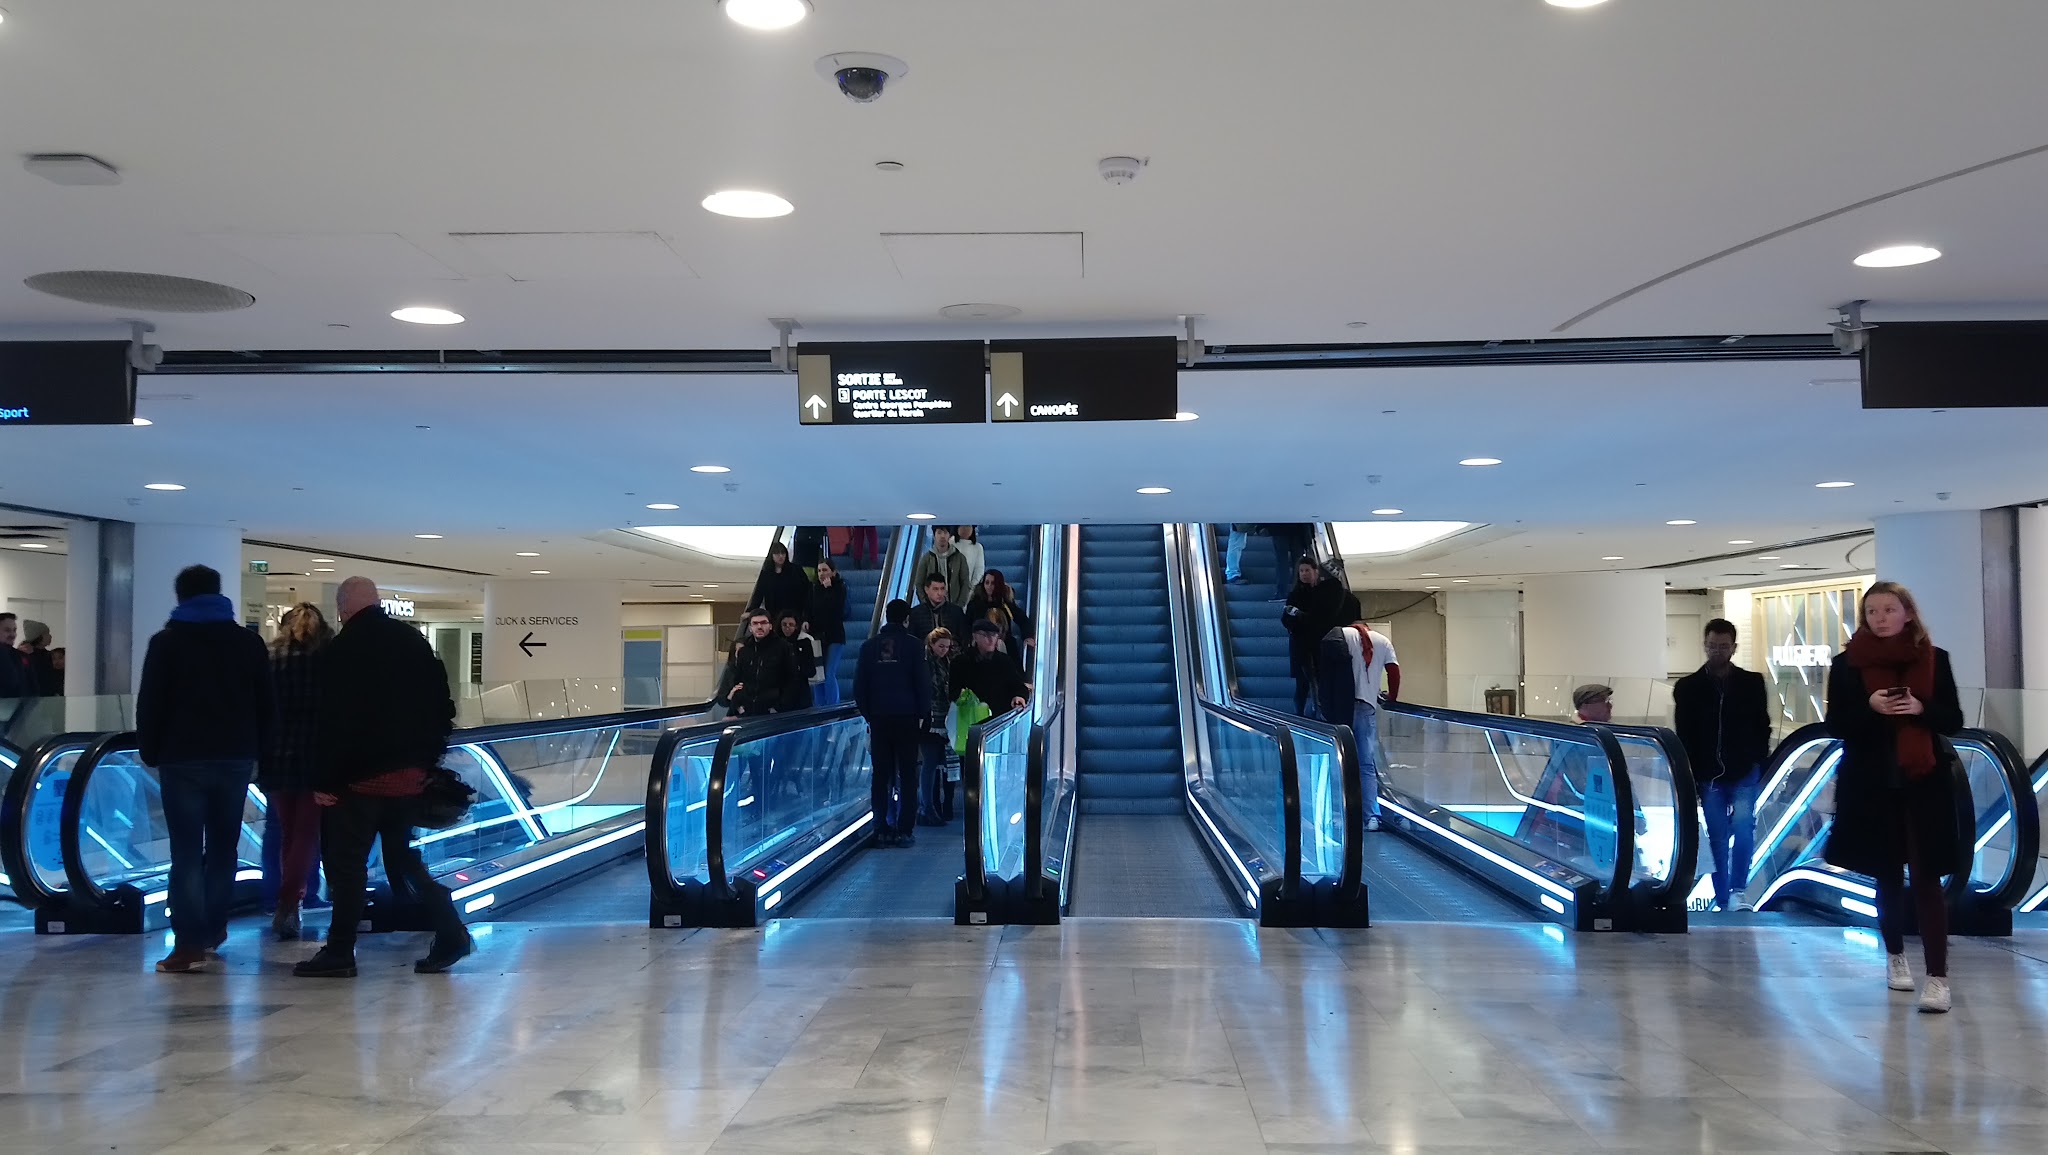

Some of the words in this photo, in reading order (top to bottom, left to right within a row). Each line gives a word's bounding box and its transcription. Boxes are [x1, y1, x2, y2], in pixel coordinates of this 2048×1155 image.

[838, 373, 881, 386] SORTIE
[853, 390, 887, 400] PORTE
[889, 389, 927, 400] LESCOT
[1030, 402, 1079, 416] CANOPÉE
[380, 594, 415, 617] ervices
[520, 617, 527, 625] &
[528, 617, 578, 625] SERVICES
